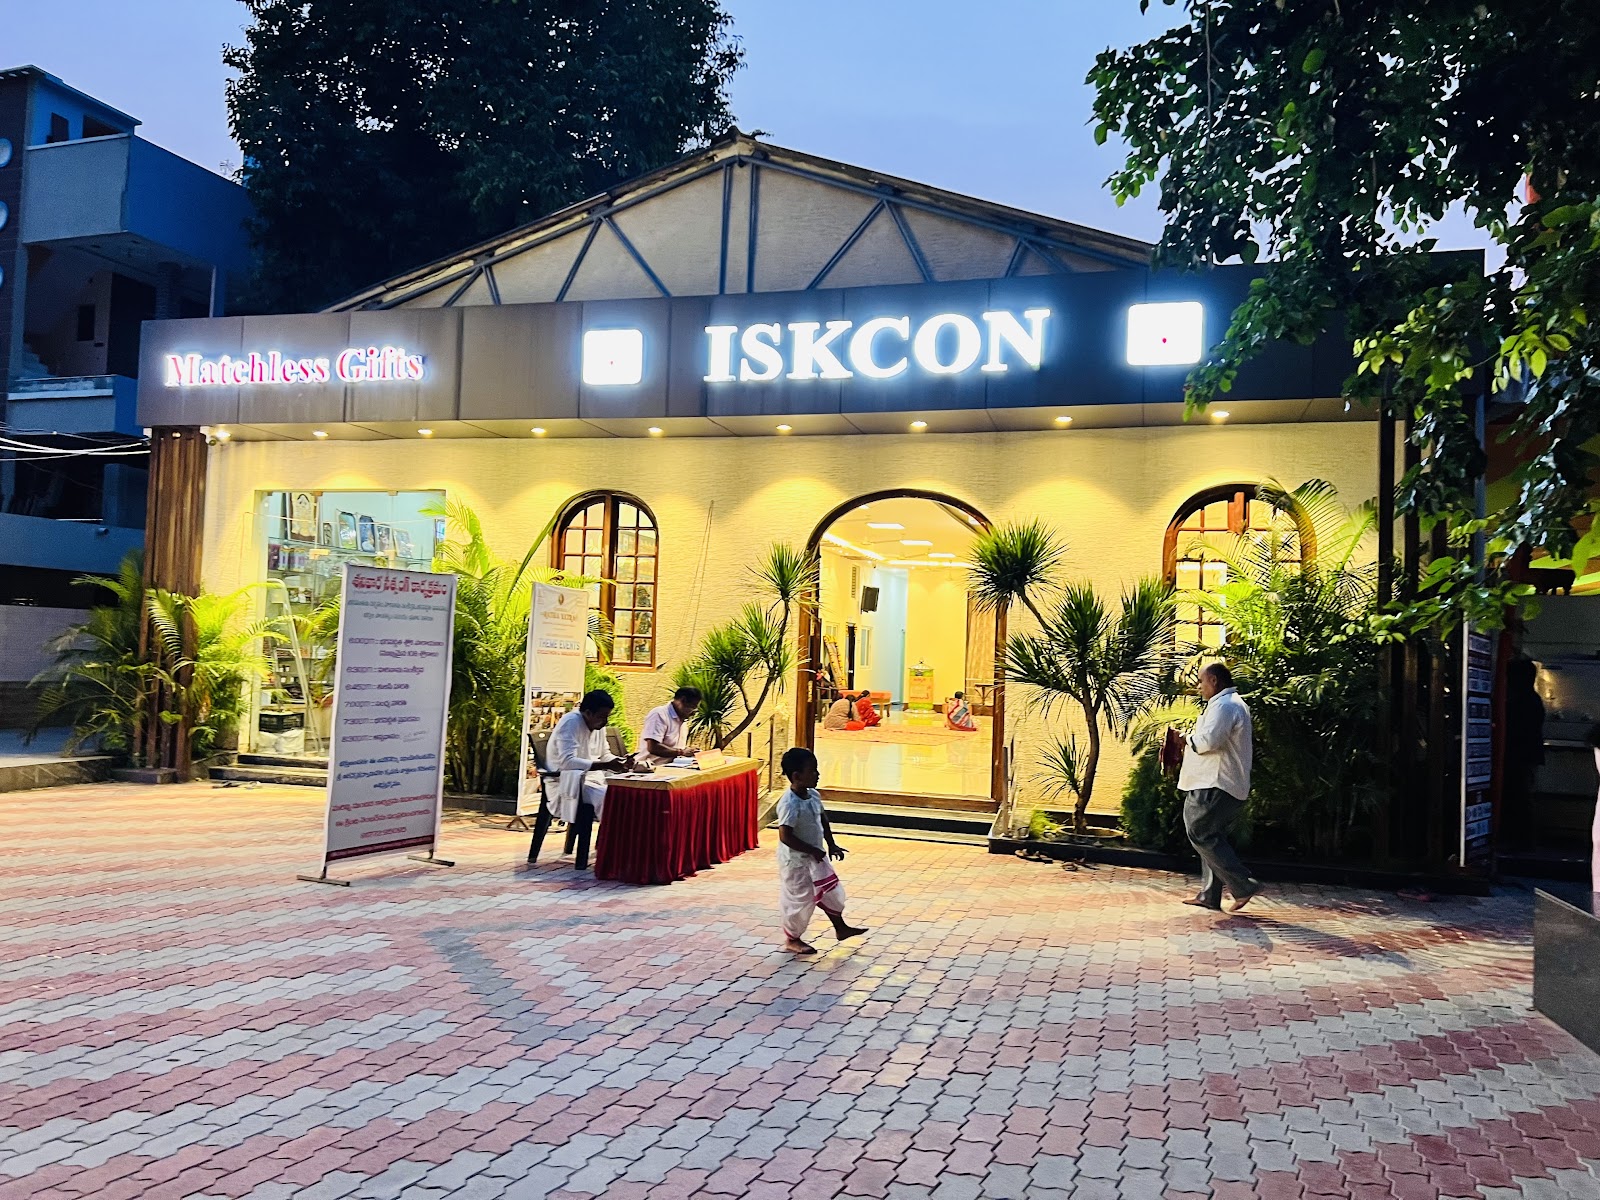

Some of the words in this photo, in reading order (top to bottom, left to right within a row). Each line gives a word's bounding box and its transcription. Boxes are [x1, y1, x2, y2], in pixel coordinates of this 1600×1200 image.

[165, 351, 330, 387] Matchless
[336, 346, 424, 382] Gifts
[704, 308, 1051, 383] ISKCON
